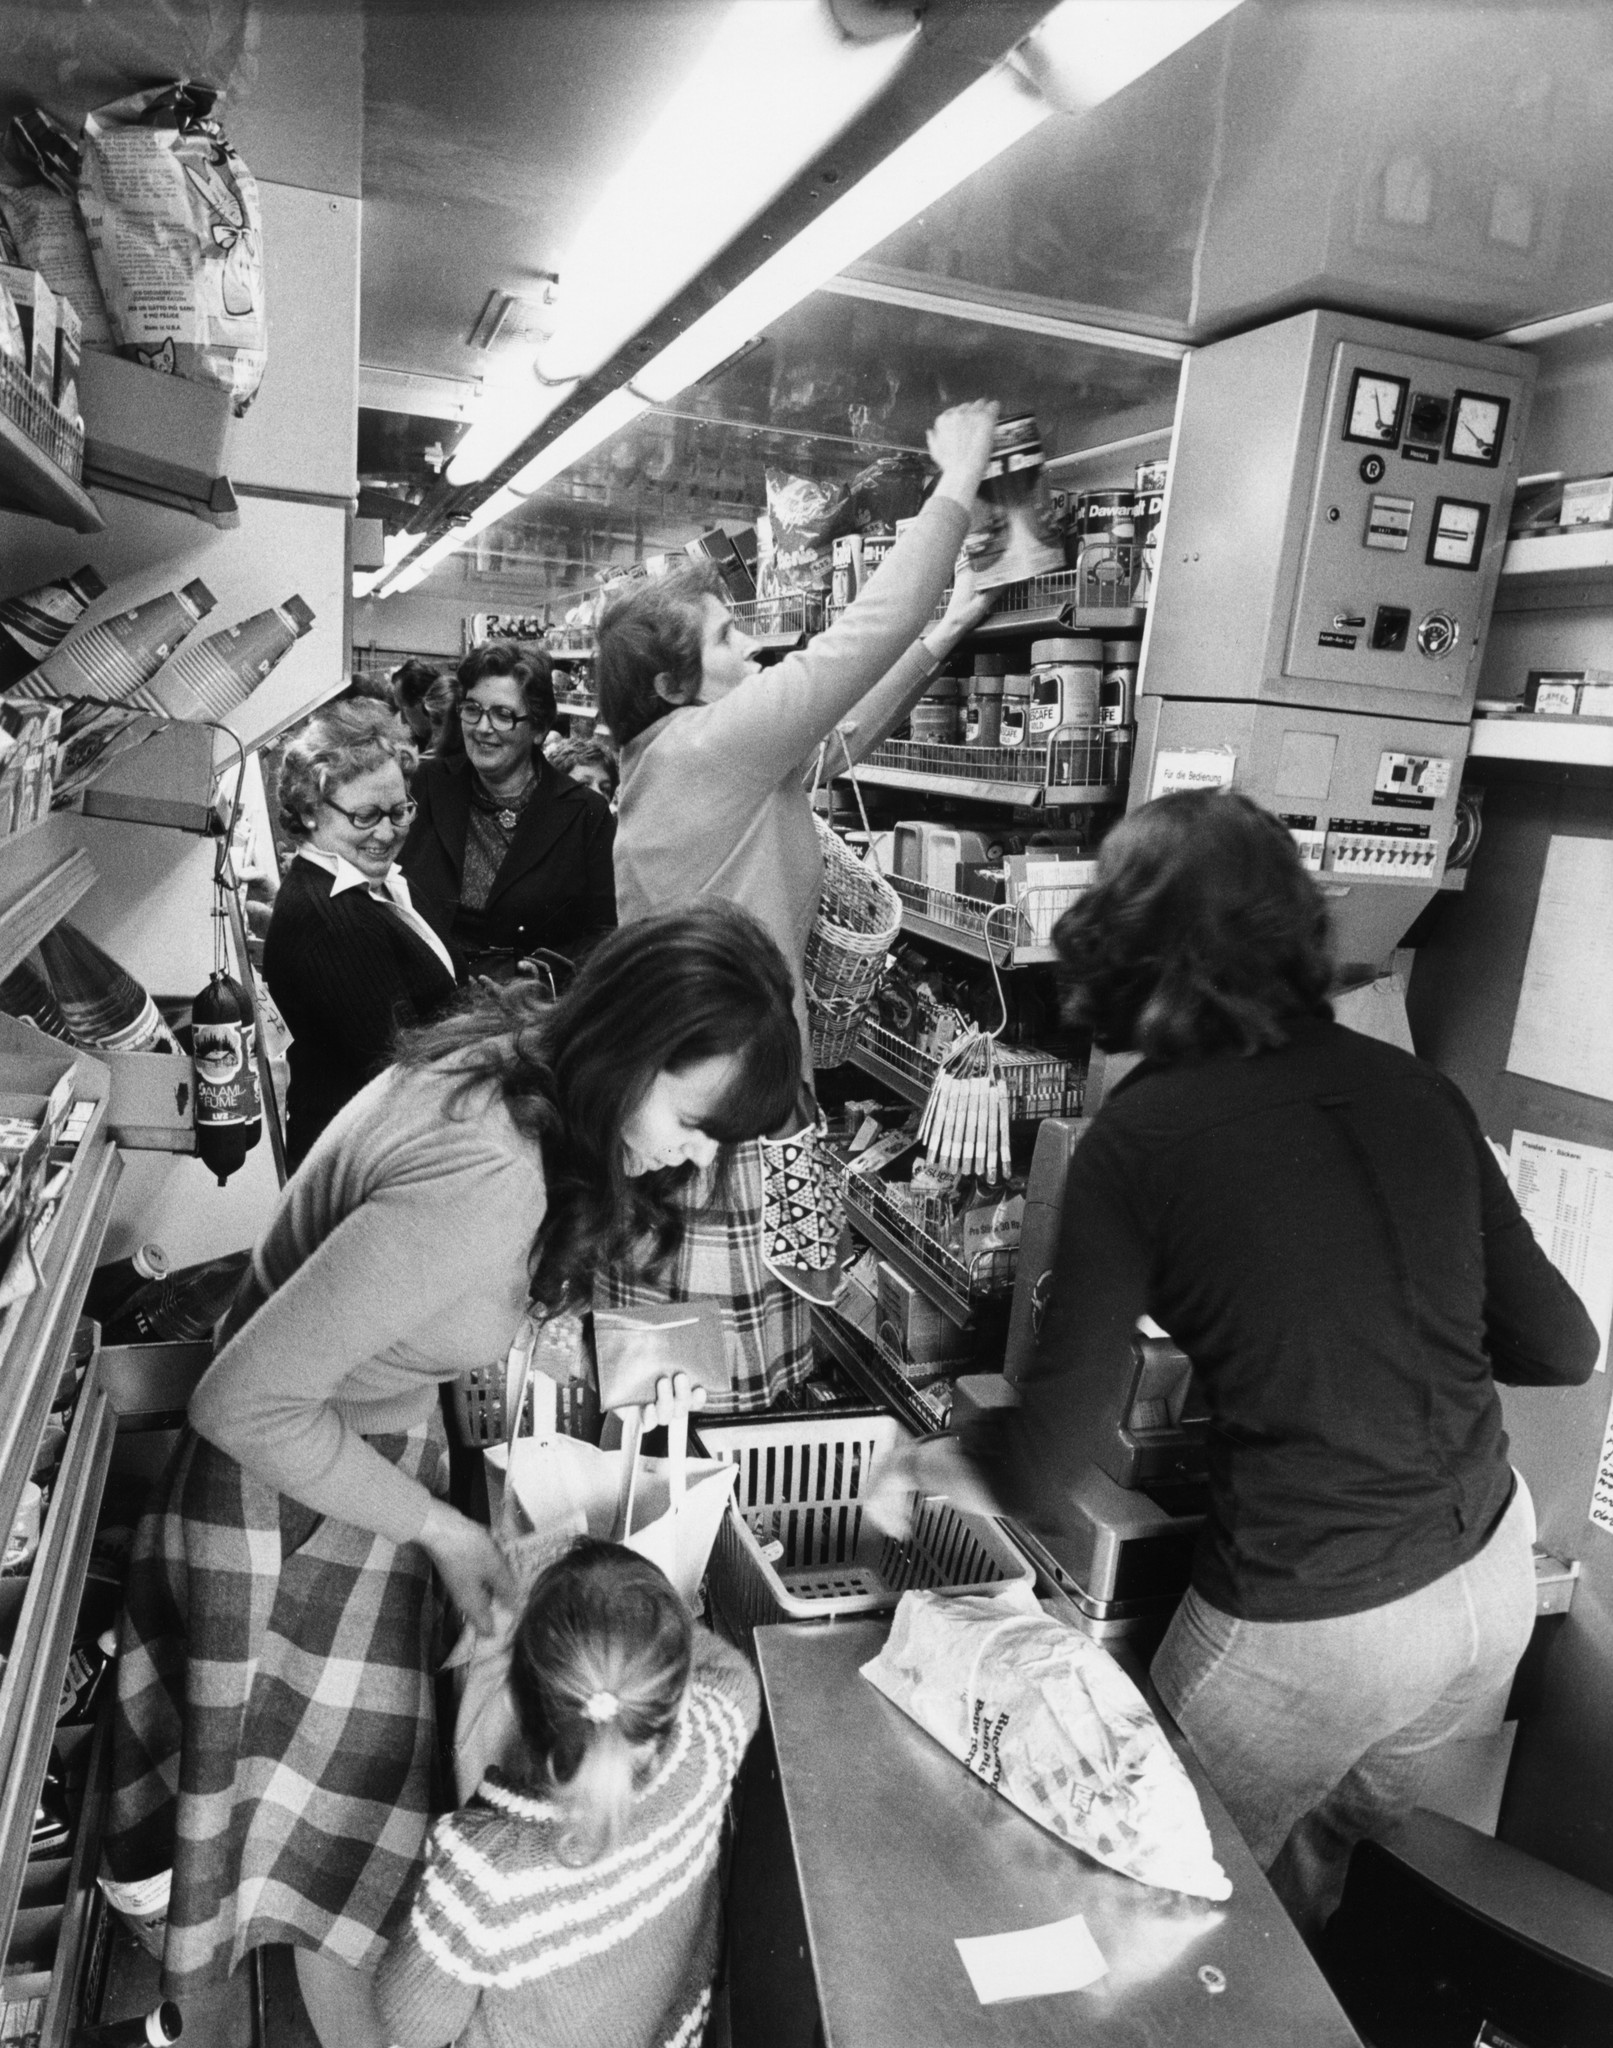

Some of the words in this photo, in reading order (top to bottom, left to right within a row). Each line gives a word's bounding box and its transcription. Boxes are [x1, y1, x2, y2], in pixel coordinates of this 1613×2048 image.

[1366, 461, 1379, 477] R
[1177, 769, 1186, 780] die
[1188, 770, 1223, 785] Bedienung
[1000, 1221, 1010, 1231] 30
